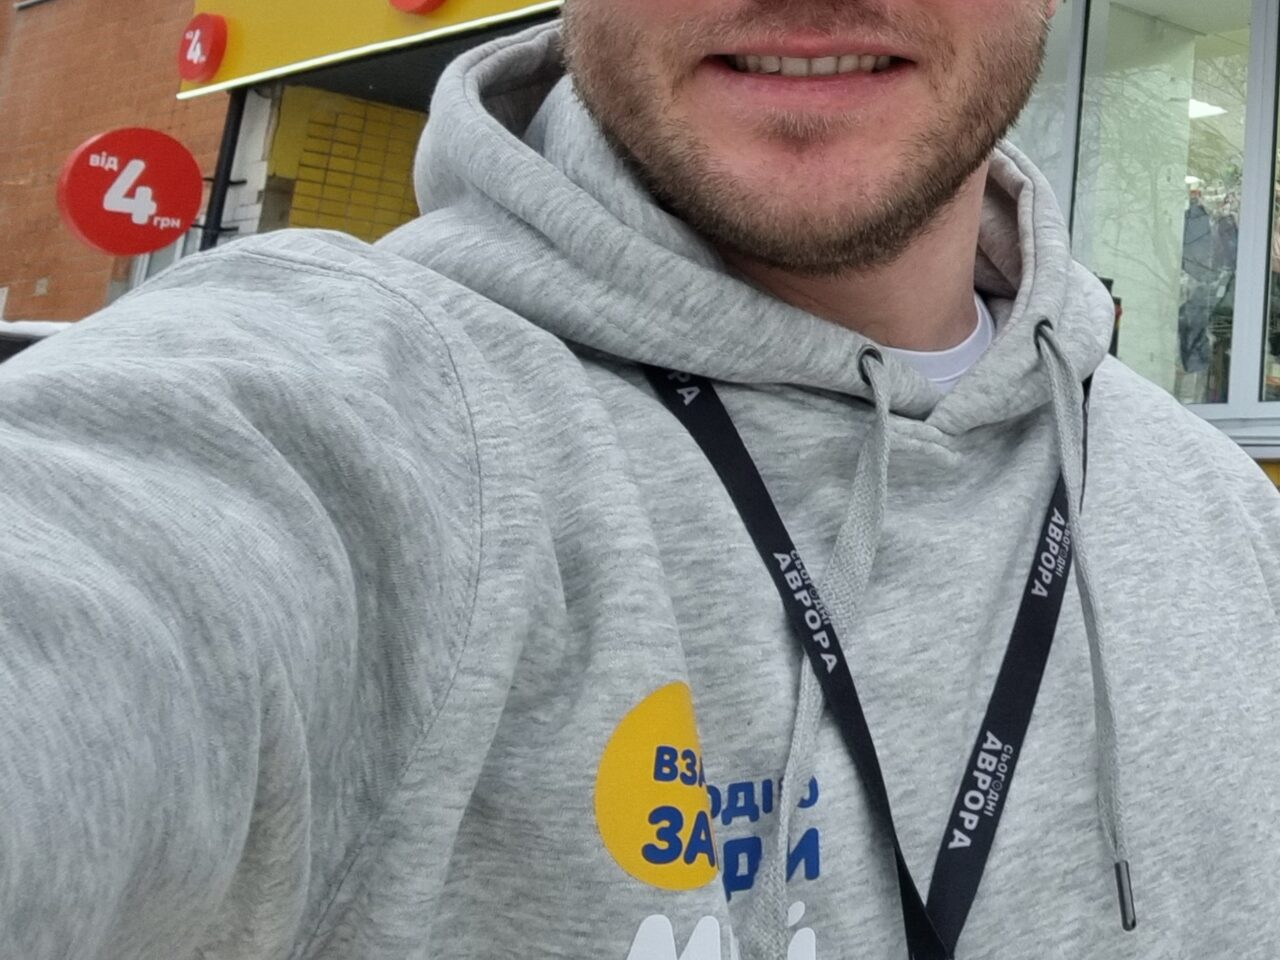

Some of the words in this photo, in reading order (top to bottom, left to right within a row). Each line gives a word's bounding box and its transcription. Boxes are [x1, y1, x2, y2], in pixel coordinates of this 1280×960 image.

[187, 29, 201, 64] 4
[89, 151, 118, 172] від
[103, 159, 157, 225] 4
[153, 216, 181, 230] грн
[1031, 507, 1066, 597] АВРОРА
[772, 552, 837, 674] АВРОРА
[947, 730, 1003, 849] АВРОРА
